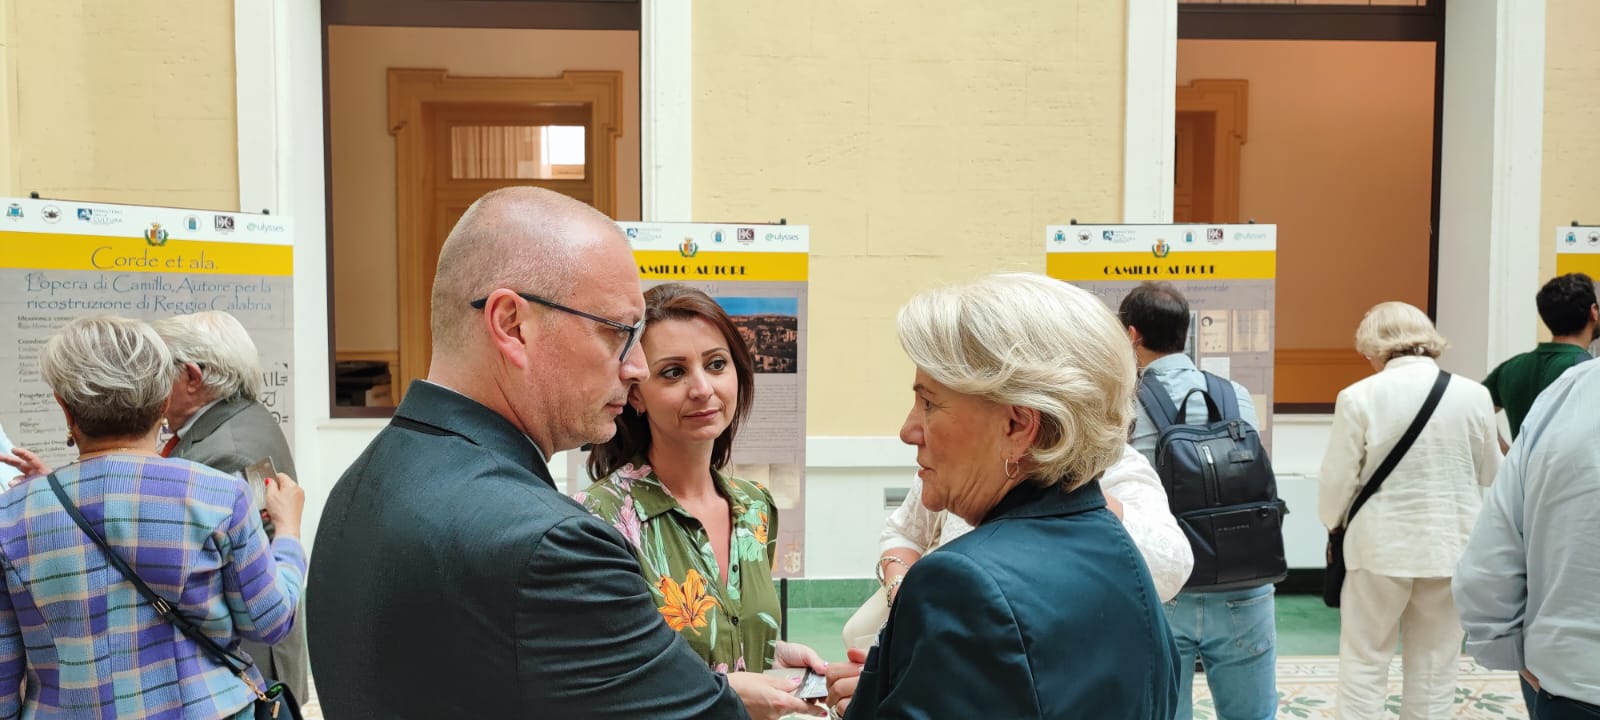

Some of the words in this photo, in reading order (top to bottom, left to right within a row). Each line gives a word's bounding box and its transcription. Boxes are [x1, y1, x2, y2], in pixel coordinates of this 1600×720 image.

[91, 246, 159, 270] Corde
[165, 255, 184, 269] et
[640, 265, 690, 275] AMILLO
[696, 265, 748, 276] AUTORE
[1103, 265, 1161, 275] CAMILLO
[1167, 265, 1217, 275] AUTORE
[93, 274, 107, 290] di
[176, 277, 231, 294] Autore
[234, 282, 257, 297] per
[260, 278, 272, 293] la
[26, 296, 132, 310] ricostruzione
[136, 294, 150, 310] di
[154, 295, 207, 314] Reggio
[211, 295, 272, 311] Calabria
